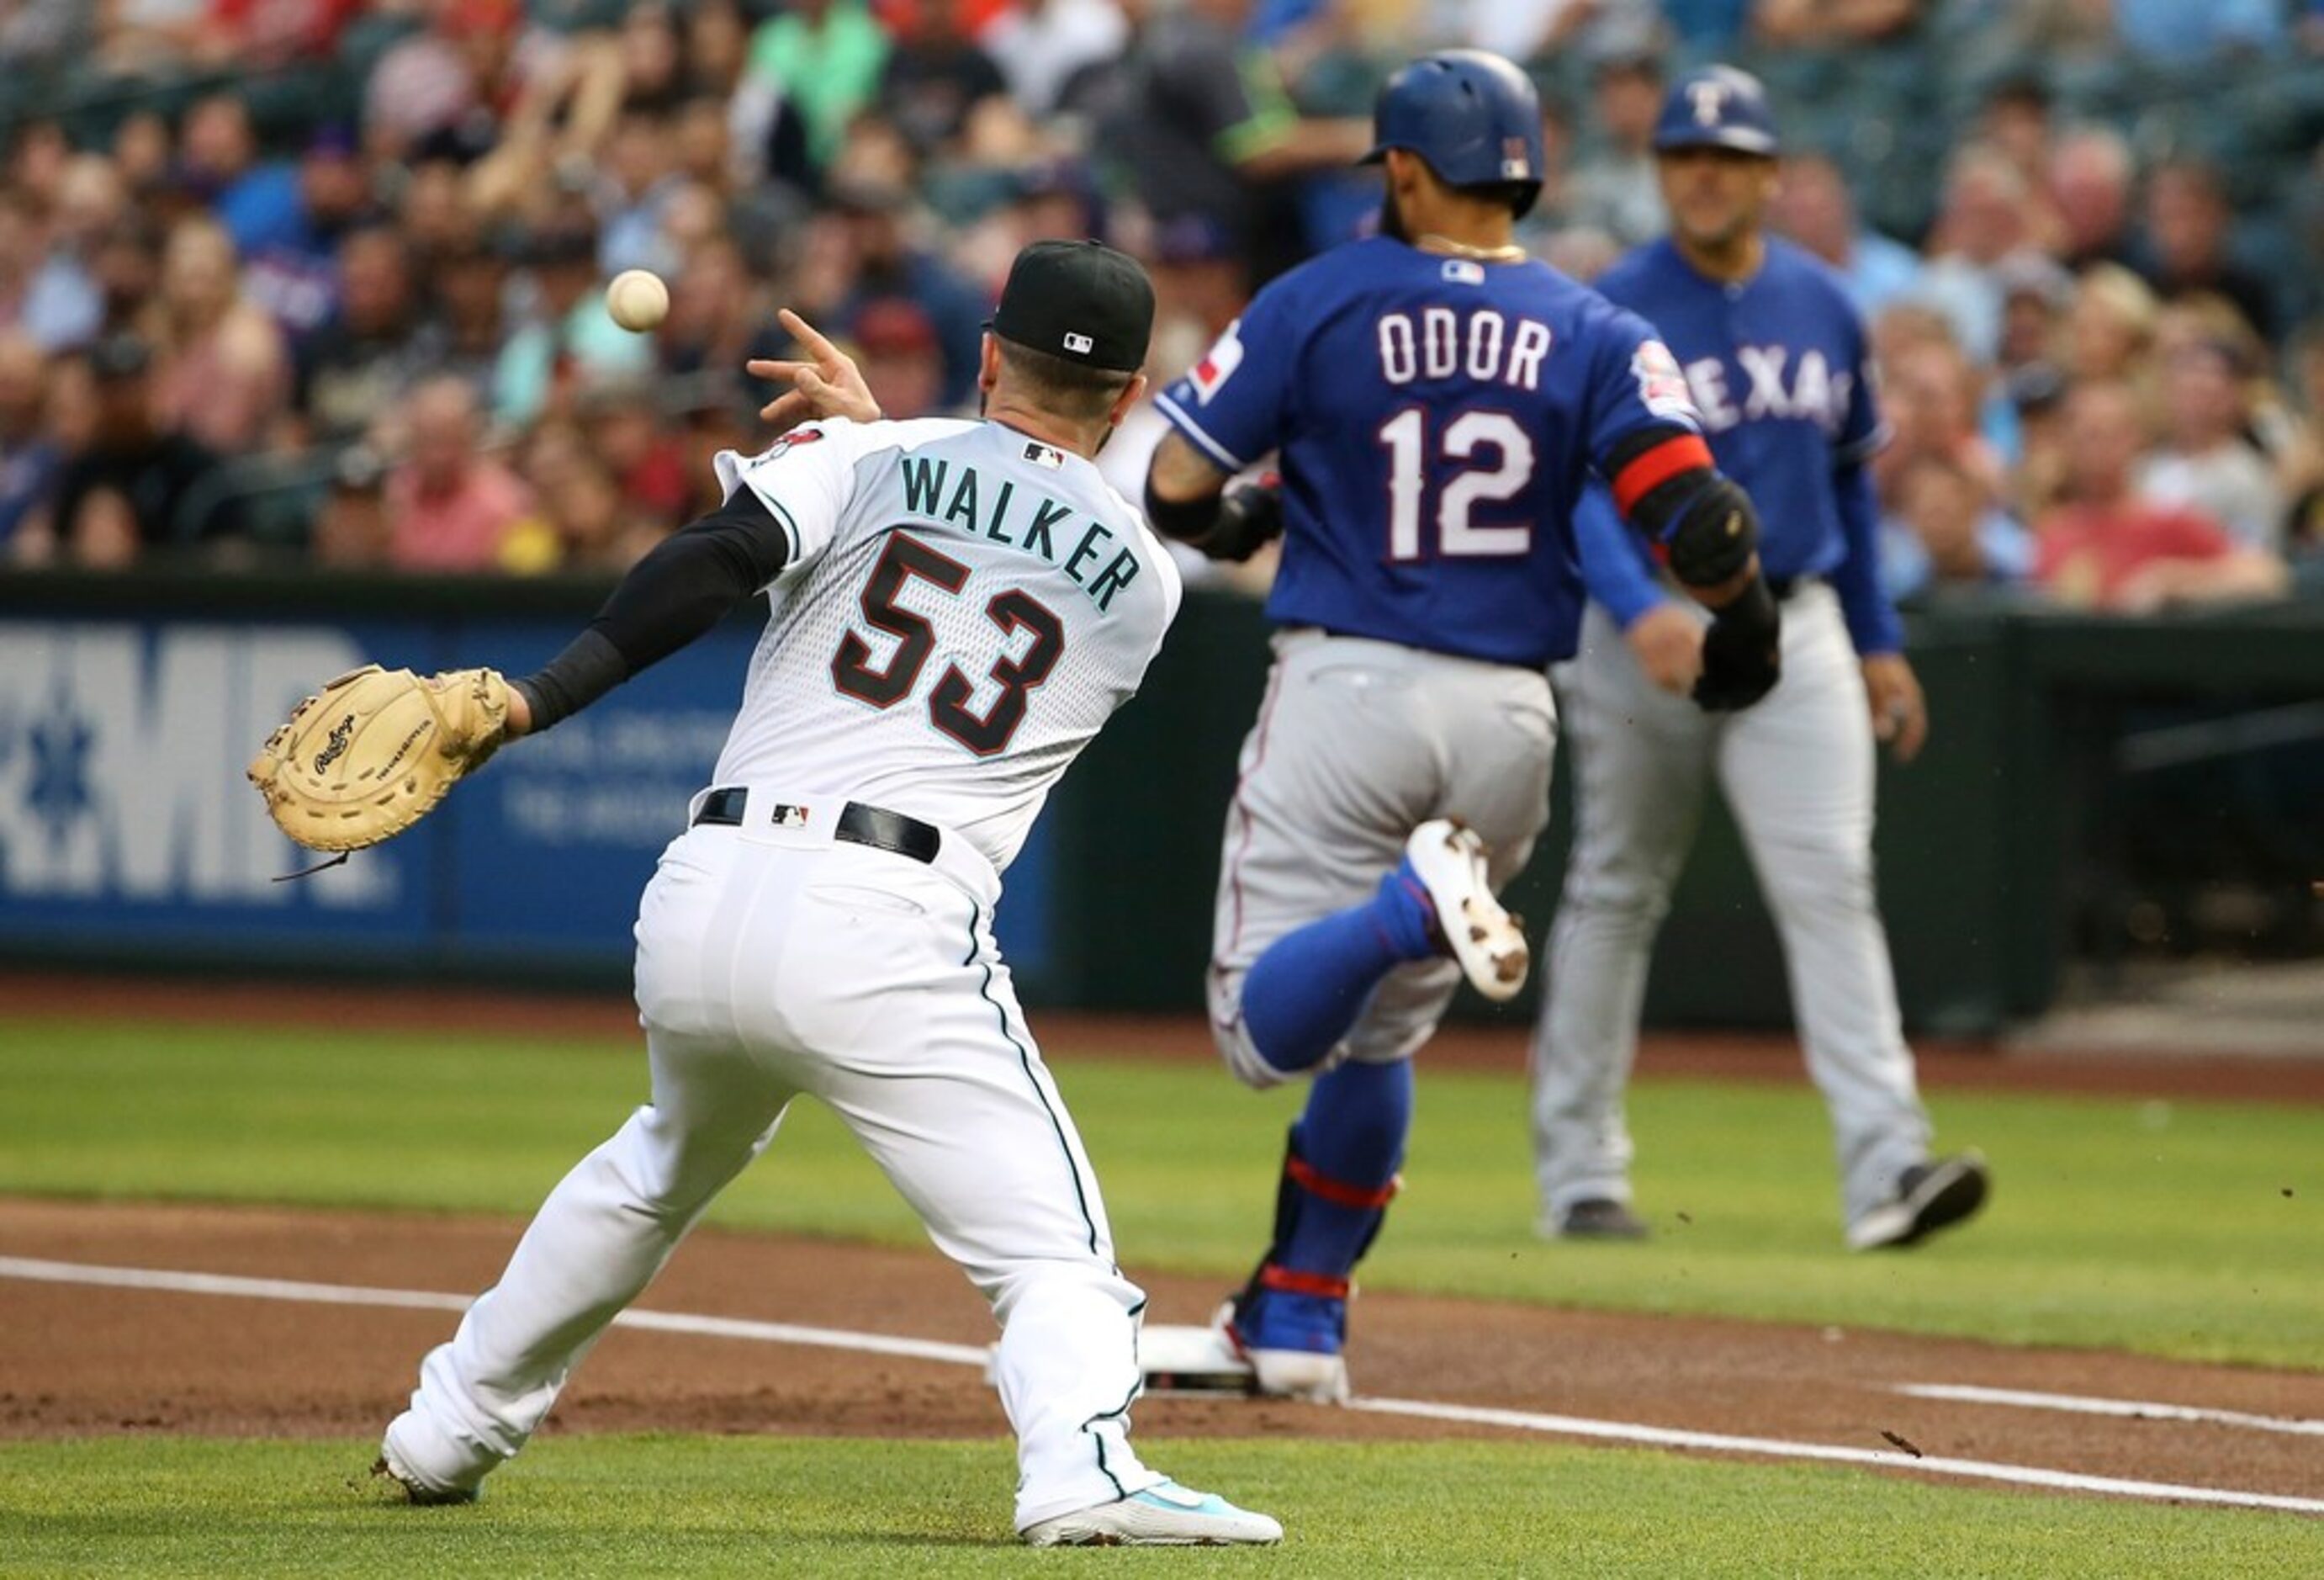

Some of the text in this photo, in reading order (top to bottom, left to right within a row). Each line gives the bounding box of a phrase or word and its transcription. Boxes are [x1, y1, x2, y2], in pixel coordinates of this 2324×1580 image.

[1685, 82, 1732, 127] T
[1378, 306, 1553, 392] ODOR
[1683, 343, 1854, 436] EXA
[899, 455, 1141, 614] WALKER
[1376, 406, 1538, 562] 12
[828, 528, 1067, 758] 53
